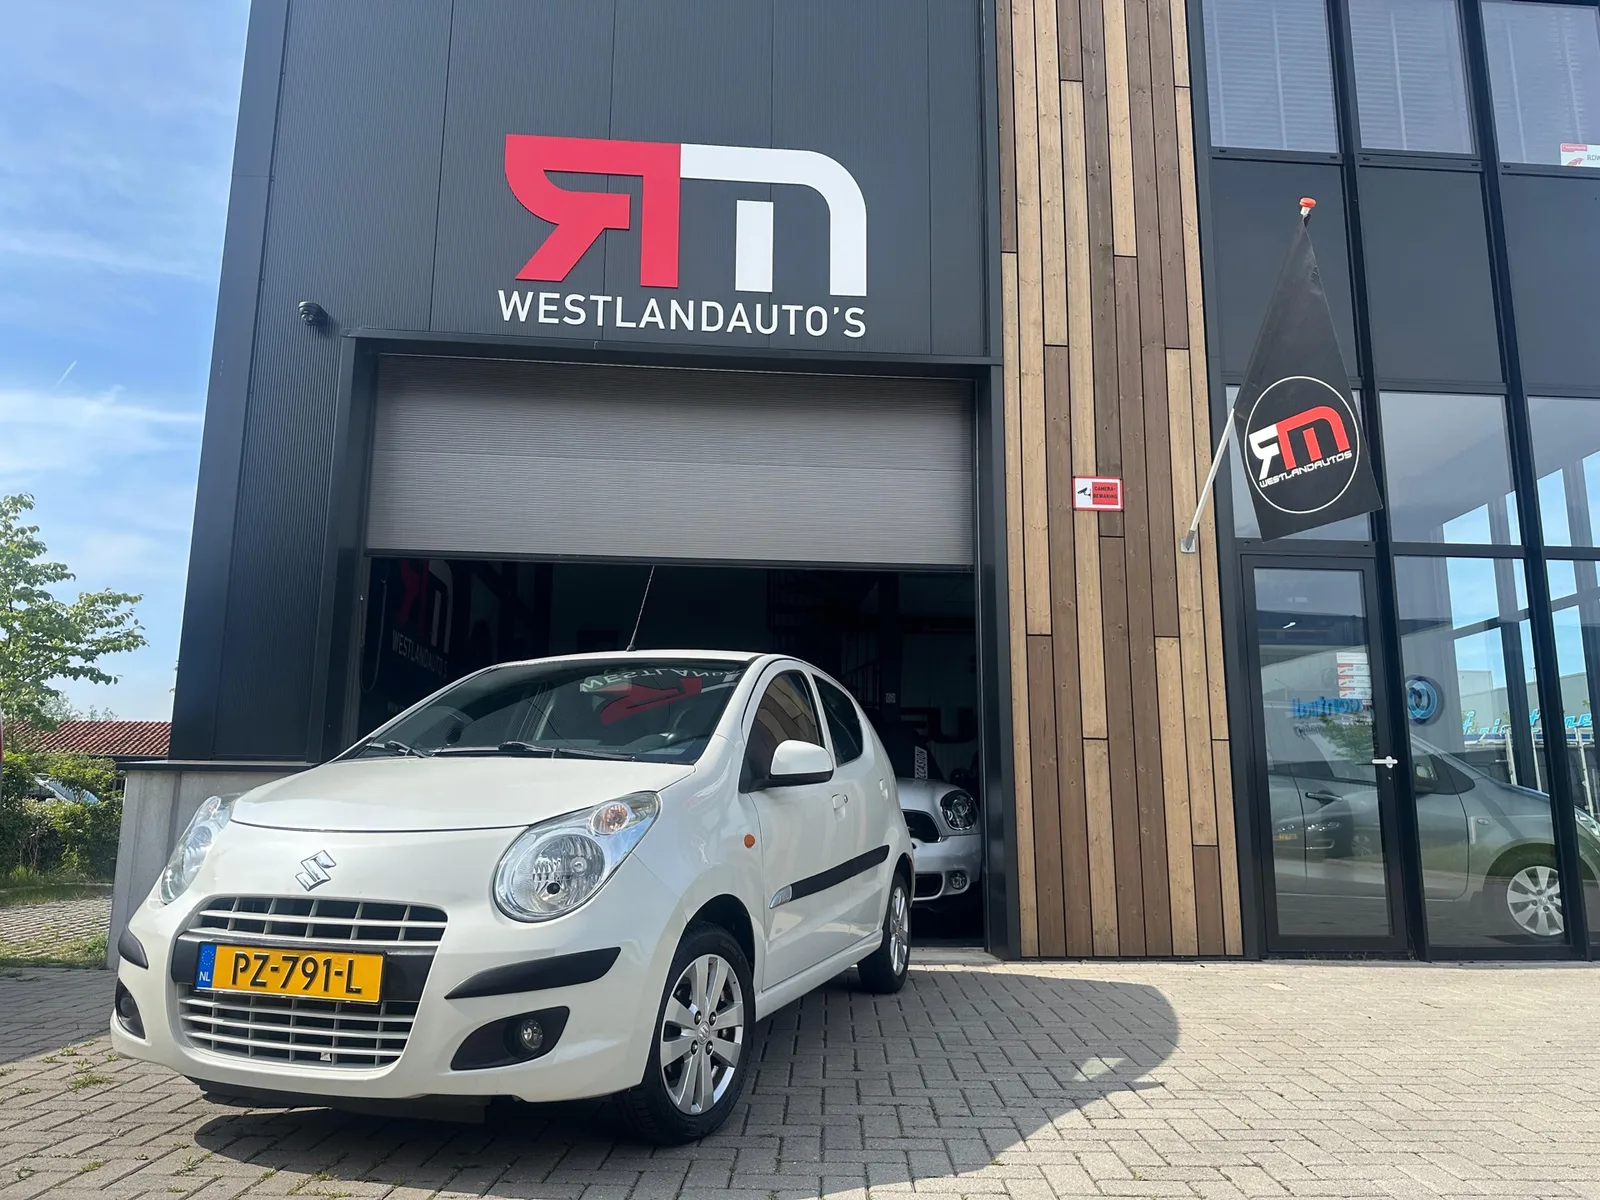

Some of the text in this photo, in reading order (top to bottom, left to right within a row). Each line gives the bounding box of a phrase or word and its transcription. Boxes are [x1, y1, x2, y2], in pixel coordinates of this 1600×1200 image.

[497, 289, 867, 338] WESTLANDAUTO'S
[1259, 450, 1353, 488] WESTLANDAUTOS
[199, 971, 211, 982] NL
[231, 951, 362, 994] PZ-791-L
